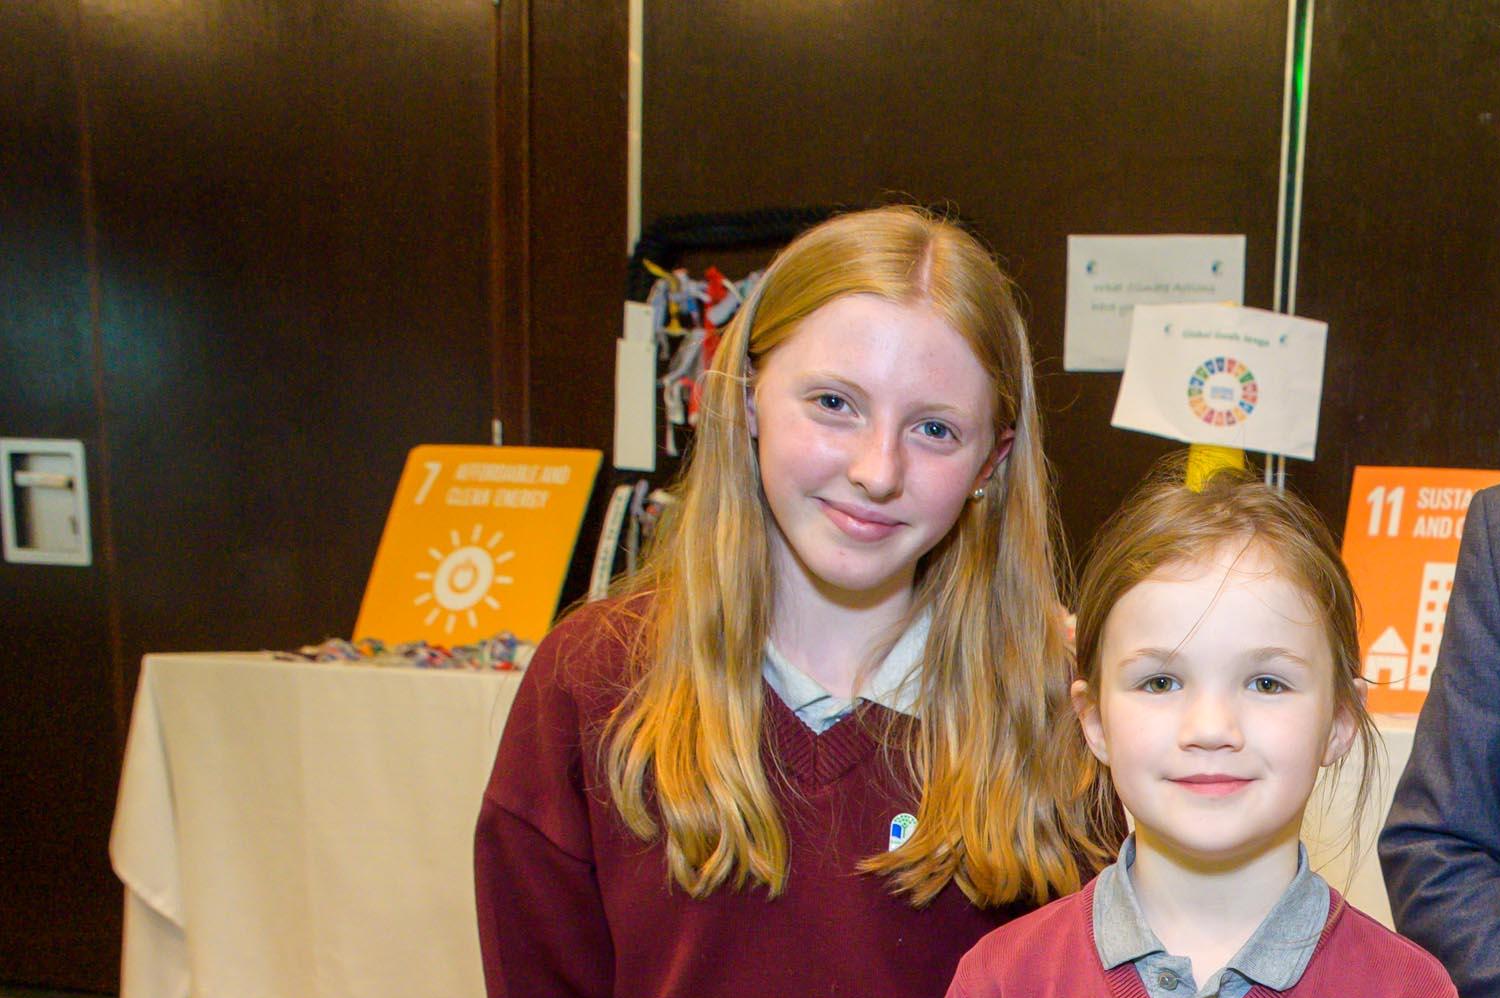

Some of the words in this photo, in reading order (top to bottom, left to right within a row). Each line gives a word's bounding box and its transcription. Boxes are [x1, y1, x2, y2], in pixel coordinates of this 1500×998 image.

[415, 461, 442, 505] 7
[445, 485, 491, 507] CLEAN
[493, 487, 550, 509] ENERGY
[1366, 486, 1405, 537] 11
[1413, 517, 1451, 539] AND
